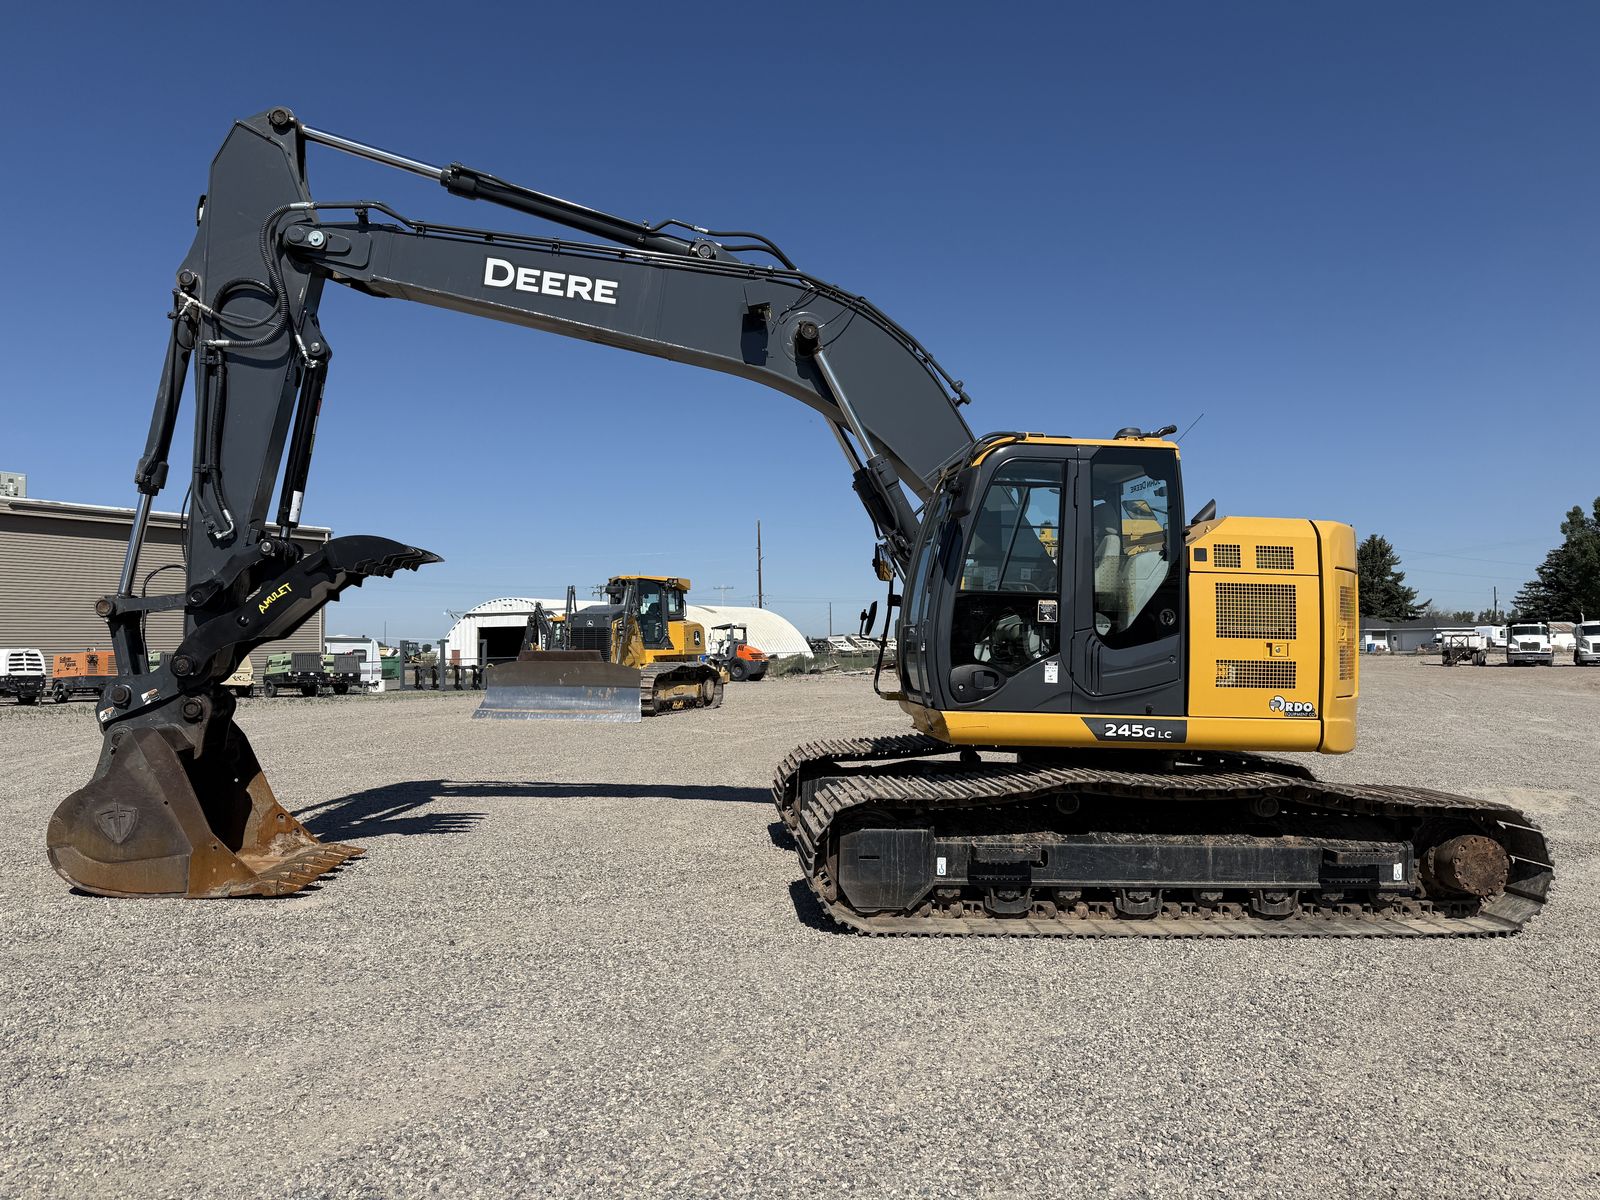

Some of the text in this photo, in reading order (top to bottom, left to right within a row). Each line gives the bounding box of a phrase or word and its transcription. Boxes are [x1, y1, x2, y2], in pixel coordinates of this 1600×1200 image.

[484, 257, 619, 305] DEERE
[258, 582, 292, 614] AMULET
[1285, 702, 1313, 712] RDO
[1105, 723, 1172, 739] 245G LC
